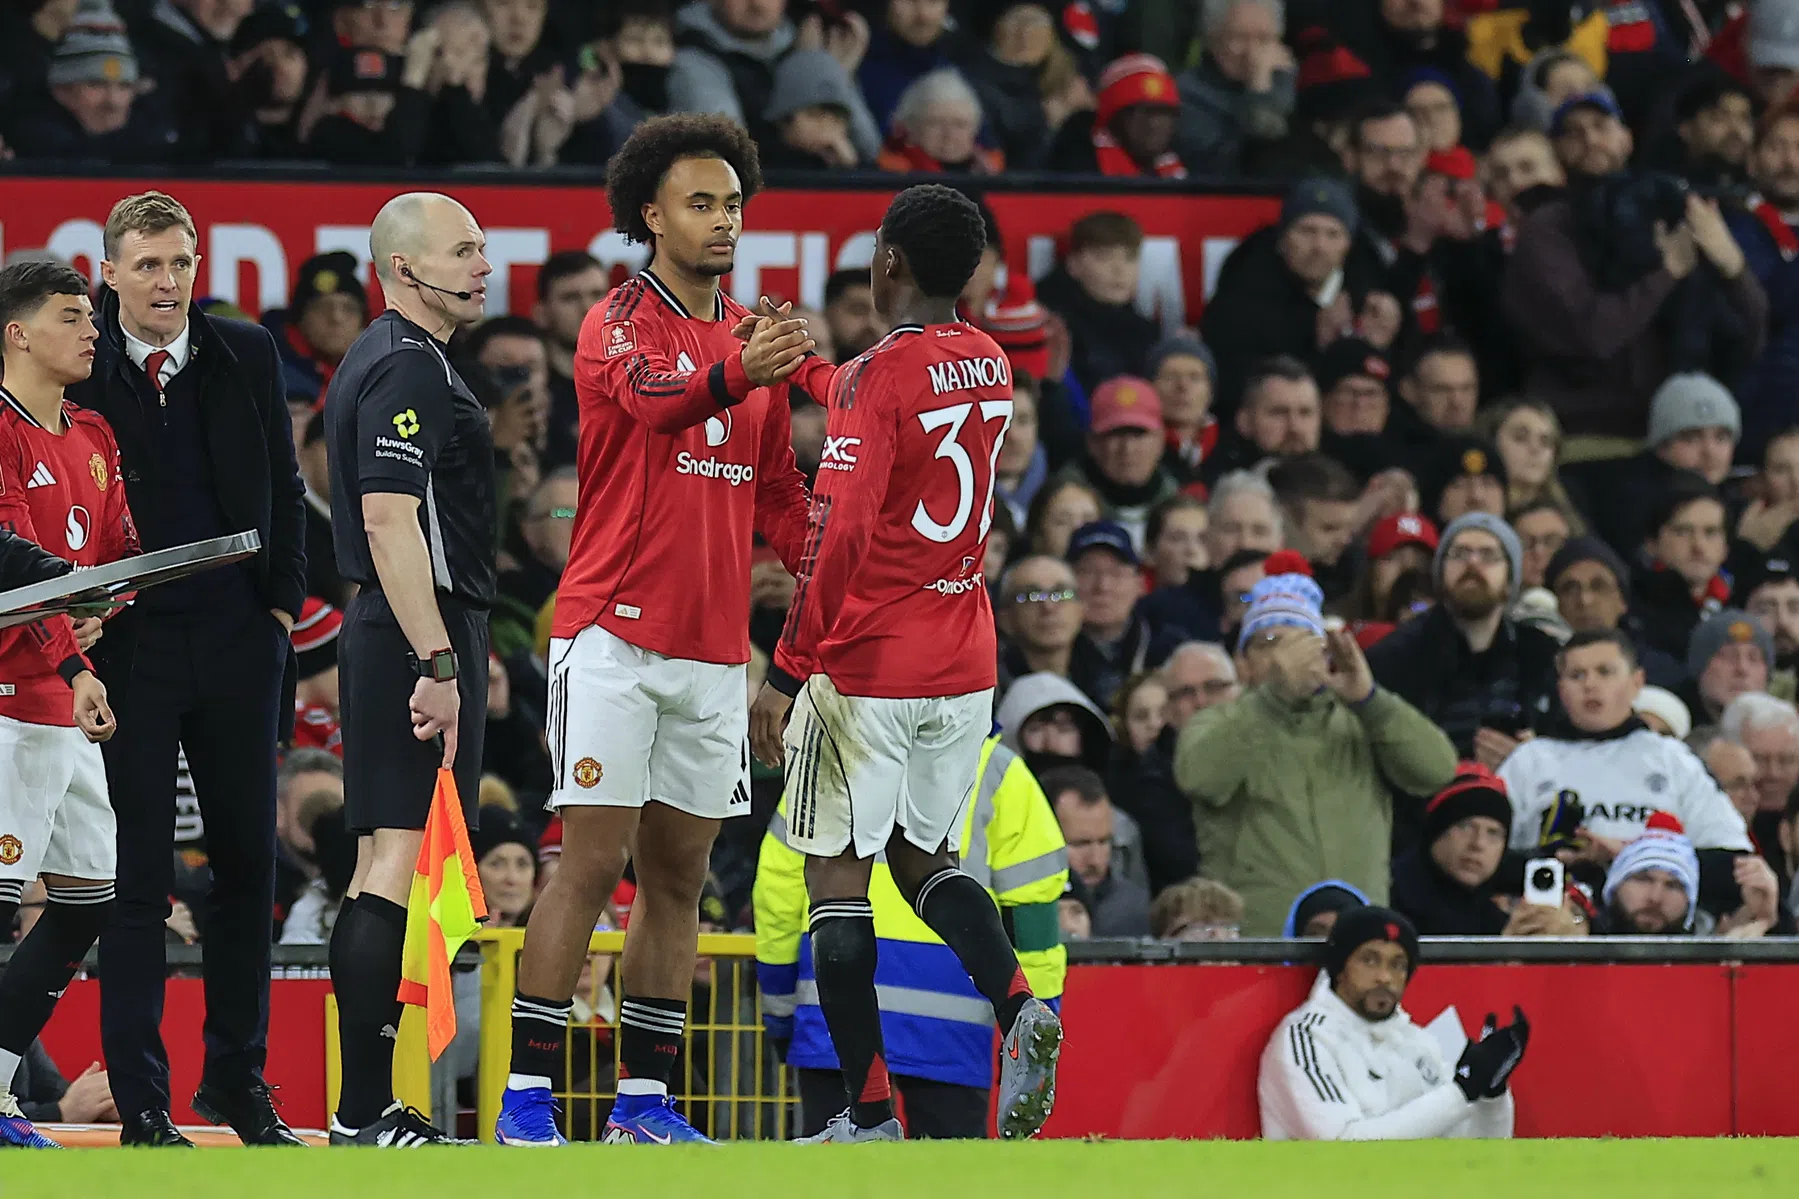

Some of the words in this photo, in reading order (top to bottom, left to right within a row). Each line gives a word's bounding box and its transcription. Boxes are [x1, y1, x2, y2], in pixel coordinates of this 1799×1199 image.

[926, 356, 1008, 396] MAINOO
[375, 450, 401, 460] Building
[911, 400, 1014, 545] 37
